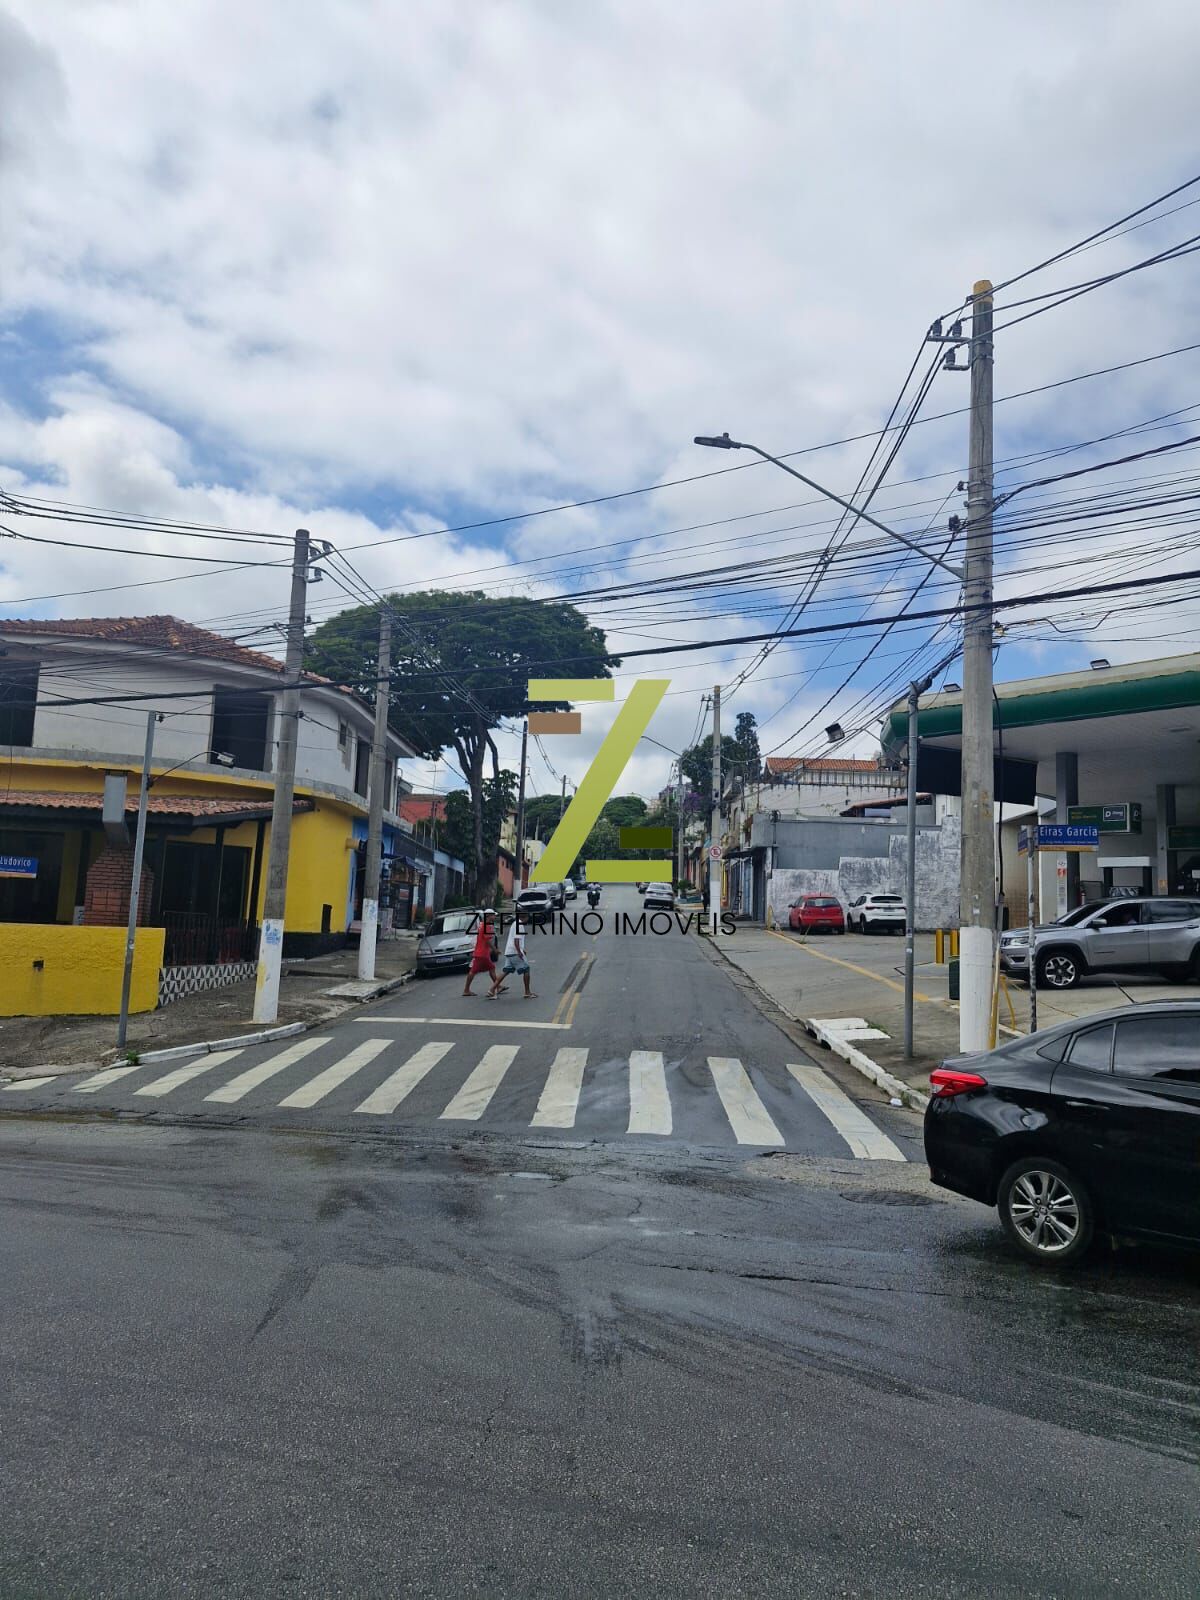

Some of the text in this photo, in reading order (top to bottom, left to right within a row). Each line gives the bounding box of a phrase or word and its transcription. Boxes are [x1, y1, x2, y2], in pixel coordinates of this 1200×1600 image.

[1039, 825, 1098, 837] Eiras Garcia
[0, 856, 32, 867] Ludovico
